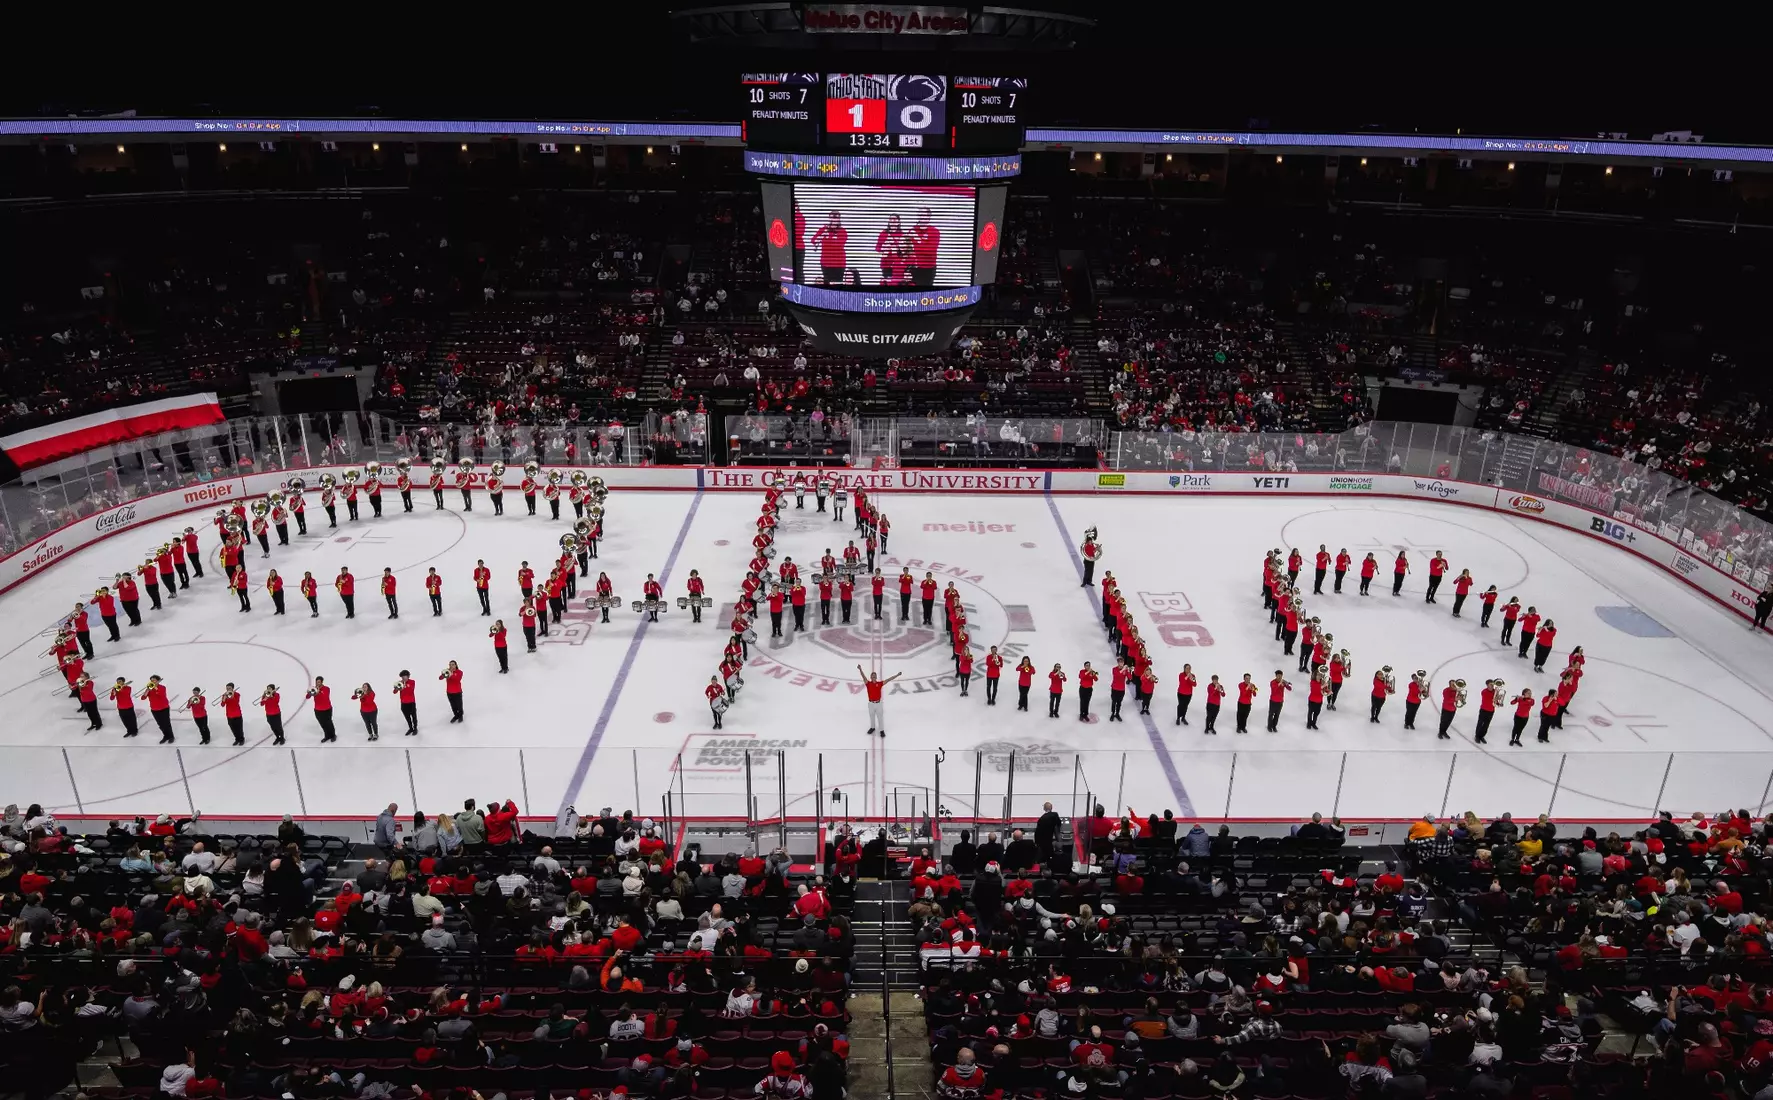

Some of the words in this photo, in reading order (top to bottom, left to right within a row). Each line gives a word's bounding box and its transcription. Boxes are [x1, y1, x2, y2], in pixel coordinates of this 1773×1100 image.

[805, 10, 860, 28] Value
[864, 10, 905, 33] City
[907, 12, 967, 30] Arena
[750, 88, 764, 103] 10
[769, 92, 790, 100] SHOTS
[800, 89, 807, 104] 7
[961, 93, 976, 108] 10
[981, 96, 1001, 105] SHOTS
[1009, 94, 1016, 108] 7
[752, 110, 779, 119] PENALTY
[781, 111, 808, 120] MINUTES
[848, 104, 864, 128] 1
[900, 105, 932, 129] 0
[963, 114, 990, 124] PENALTY
[991, 115, 1016, 124] MINUTES
[849, 134, 890, 147] 13:34
[904, 135, 918, 145] 1st
[764, 159, 779, 169] Now
[782, 160, 793, 169] On
[947, 163, 970, 175] Shop
[973, 163, 990, 173] Now
[864, 298, 892, 308] Shop
[896, 299, 917, 307] Now
[921, 297, 934, 306] On
[938, 296, 952, 304] Our
[954, 294, 967, 302] App
[834, 332, 869, 344] VALUE
[873, 335, 899, 344] CITY
[901, 332, 935, 343] ARENA
[901, 471, 1041, 489] UNIVERSITY
[1183, 475, 1211, 486] Park
[1252, 477, 1289, 488] YETI
[184, 484, 232, 504] meijer
[1427, 481, 1459, 497] Kroger
[923, 520, 1016, 535] meijer
[22, 543, 64, 573] Safelite
[884, 557, 985, 584] ARENA
[1731, 589, 1757, 610] HON
[703, 739, 808, 748] AMERICAN
[694, 757, 770, 766] POWR
[618, 1023, 636, 1032] BOOTH
